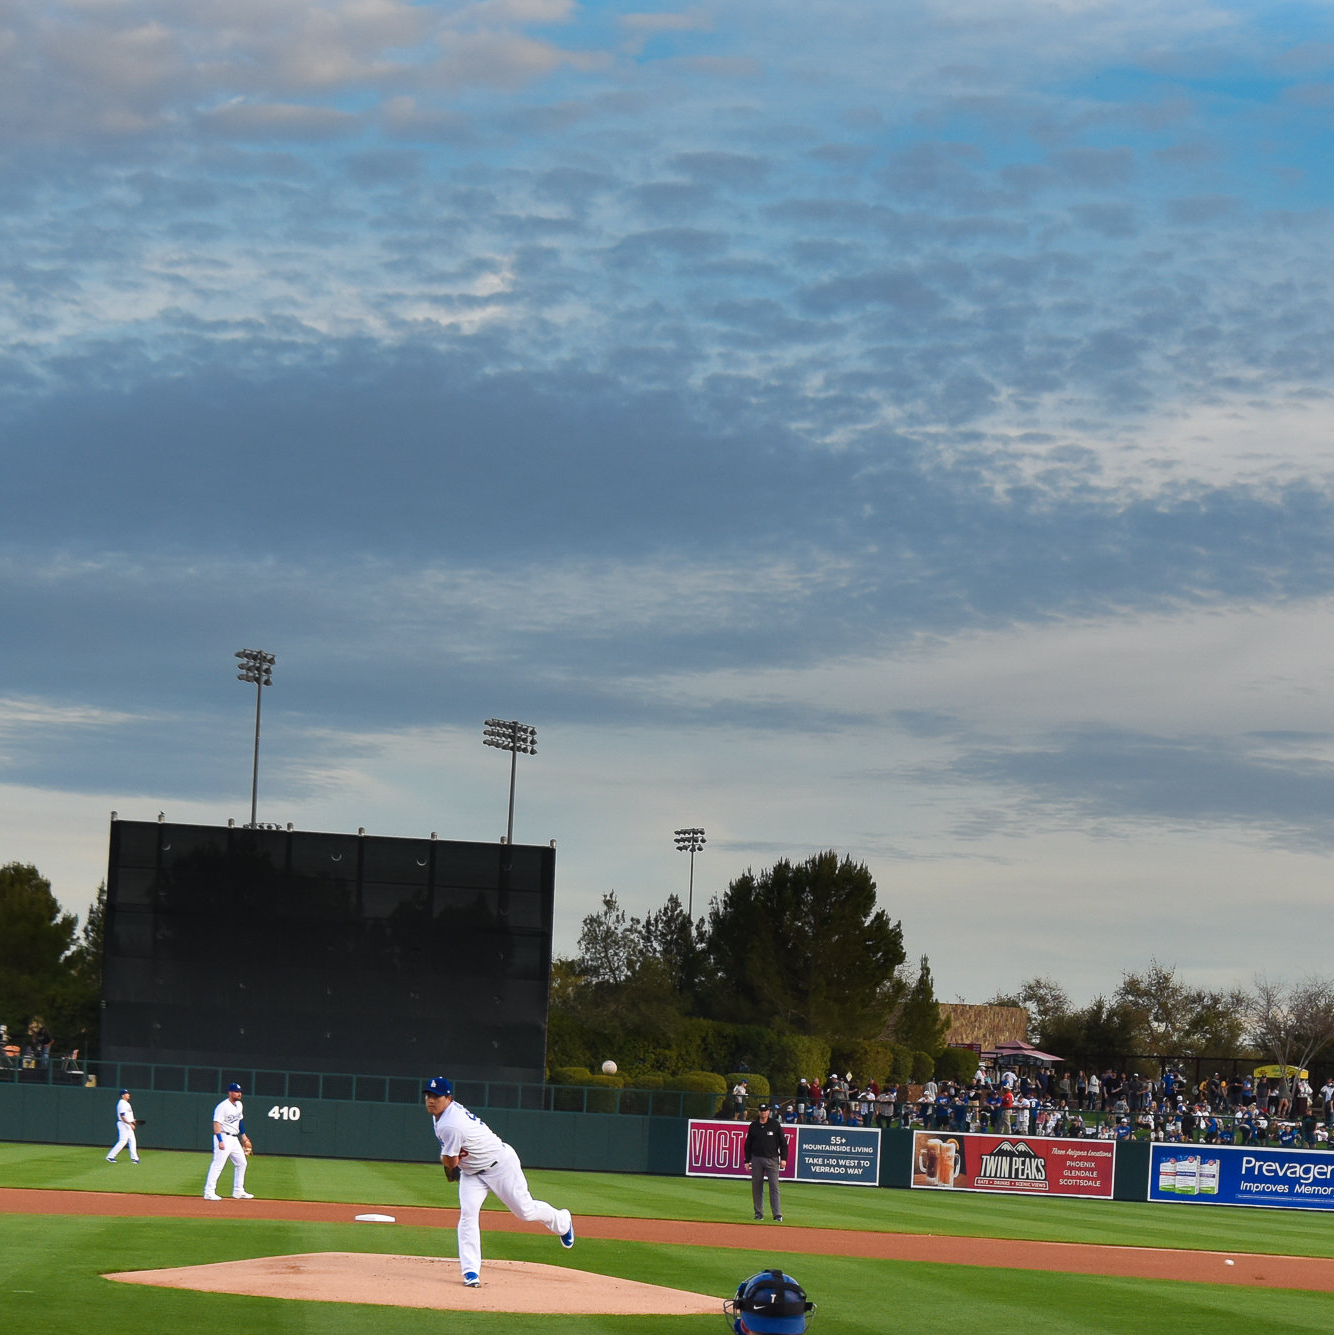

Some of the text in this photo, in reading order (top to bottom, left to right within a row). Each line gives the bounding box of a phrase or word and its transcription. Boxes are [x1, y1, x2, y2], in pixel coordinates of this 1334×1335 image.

[267, 1105, 301, 1121] 410
[830, 1136, 846, 1144] 55+
[802, 1143, 874, 1154] MOUNTAINSIDE LIVING
[804, 1157, 824, 1165] TAKE
[838, 1159, 859, 1167] WEST
[859, 1160, 870, 1168] TO
[1066, 1160, 1096, 1169] PHOENIX
[810, 1165, 864, 1175] VERRADO WAY
[980, 1155, 1046, 1181] TWIN PEAKS
[1063, 1169, 1098, 1178] GLENDALE
[1059, 1178, 1102, 1188] SCOTTSDALE
[1240, 1180, 1290, 1193] Improves
